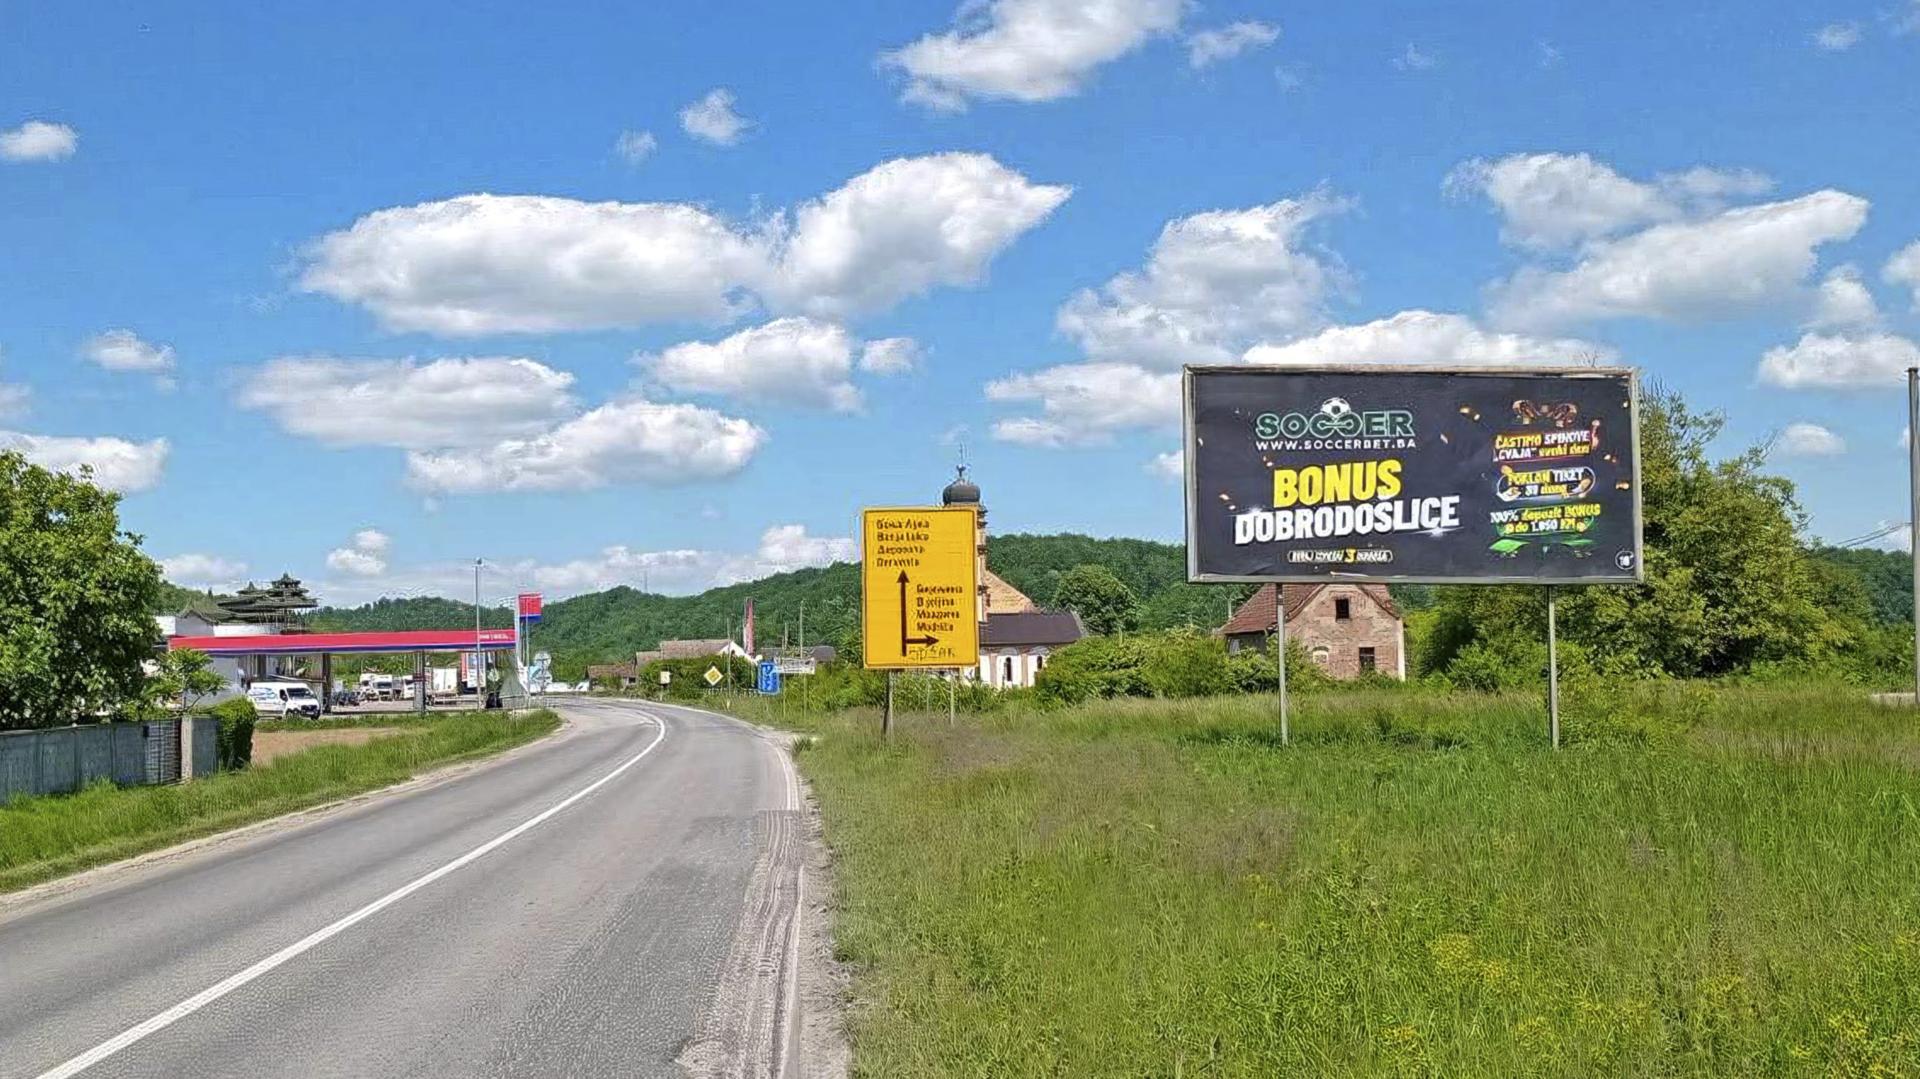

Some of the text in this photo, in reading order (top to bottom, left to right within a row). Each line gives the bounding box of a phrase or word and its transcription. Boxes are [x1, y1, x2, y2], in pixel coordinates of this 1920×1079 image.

[1255, 410, 1415, 439] SOCCER
[1255, 439, 1417, 450] WWW.SOCCERBET.BA
[1273, 459, 1402, 508] BONUS
